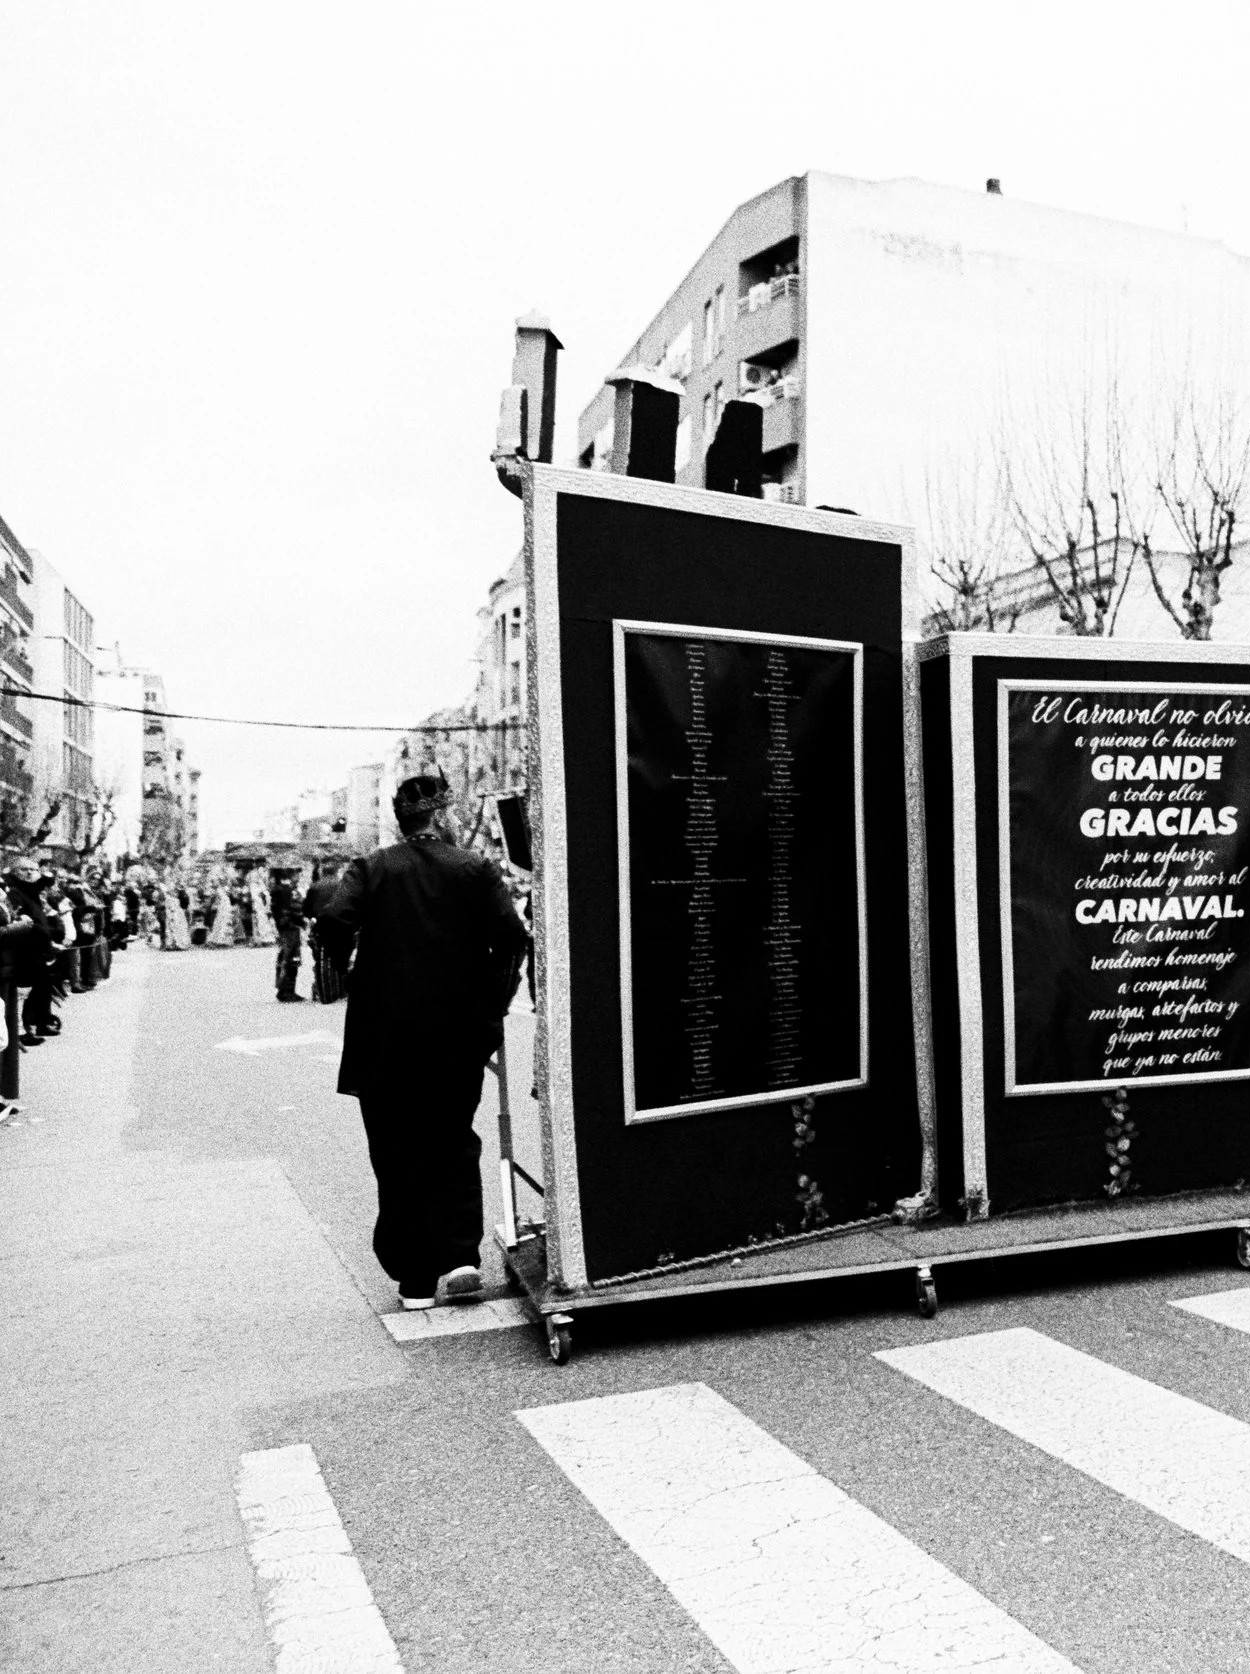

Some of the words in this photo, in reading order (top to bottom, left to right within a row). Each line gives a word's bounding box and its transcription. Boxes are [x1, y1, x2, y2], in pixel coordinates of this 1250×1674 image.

[1031, 696, 1062, 724] El
[1064, 698, 1169, 725] Carnaval
[1170, 713, 1199, 725] no
[1075, 738, 1085, 748] a
[1090, 733, 1150, 755] quienes
[1152, 729, 1170, 747] lo
[1172, 728, 1236, 748] hicieron
[1092, 756, 1222, 781] GRANDE
[1108, 792, 1119, 802] a
[1124, 783, 1165, 802] todos
[1080, 806, 1238, 837] GRACIAS
[1100, 850, 1130, 872] por
[1132, 854, 1149, 864] su
[1075, 867, 1164, 890] creatividad
[1167, 876, 1180, 895] y
[1184, 874, 1224, 887] amor
[1229, 866, 1248, 885] al
[1076, 895, 1244, 924] CARNAVAL.
[1113, 924, 1143, 944] Este
[1146, 922, 1218, 942] Carnaval
[1091, 950, 1162, 970] rendimos
[1164, 947, 1237, 970] homenaje
[1118, 983, 1129, 994] a
[1152, 995, 1224, 1025] artefactos
[1226, 1003, 1240, 1019] y
[1105, 1031, 1156, 1054] grupos
[1158, 1025, 1222, 1042] menores
[1103, 1057, 1130, 1077] que
[1133, 1056, 1157, 1075] ya
[1159, 1054, 1179, 1065] no
